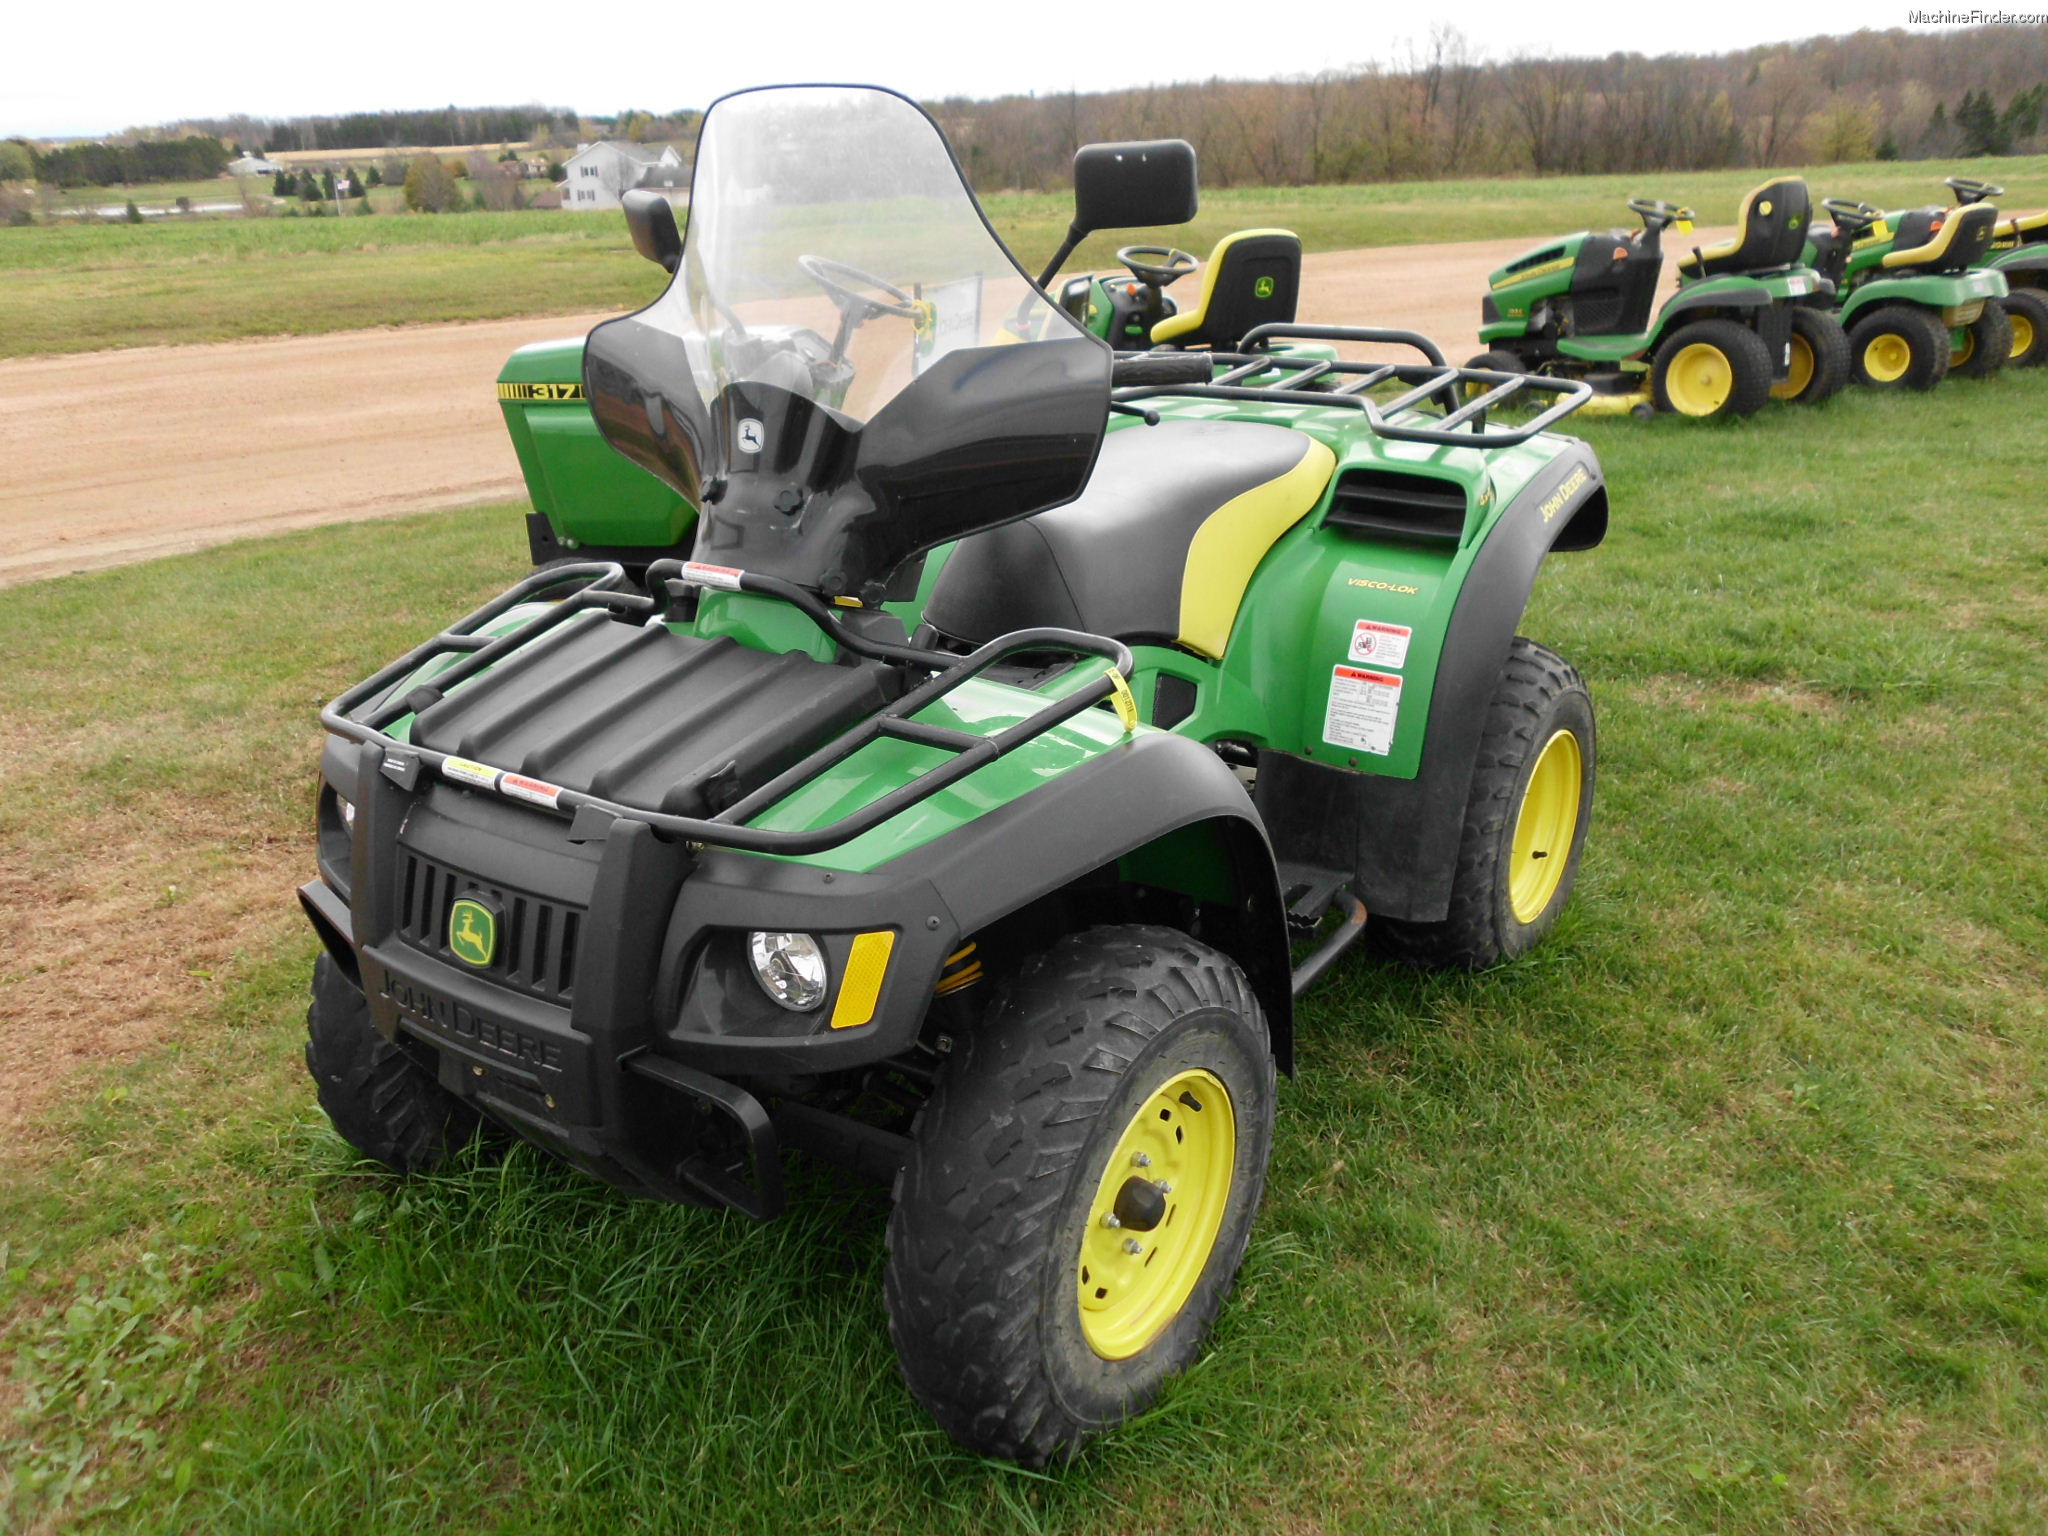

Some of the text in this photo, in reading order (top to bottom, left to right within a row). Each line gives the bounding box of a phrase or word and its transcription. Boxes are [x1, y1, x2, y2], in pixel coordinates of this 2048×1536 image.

[532, 383, 576, 400] 317
[1539, 467, 1587, 523] JOHN DEERE
[1347, 578, 1419, 595] VISCO-LOK
[1356, 672, 1385, 682] WARNING
[380, 968, 563, 1073] JOHN DEERE
